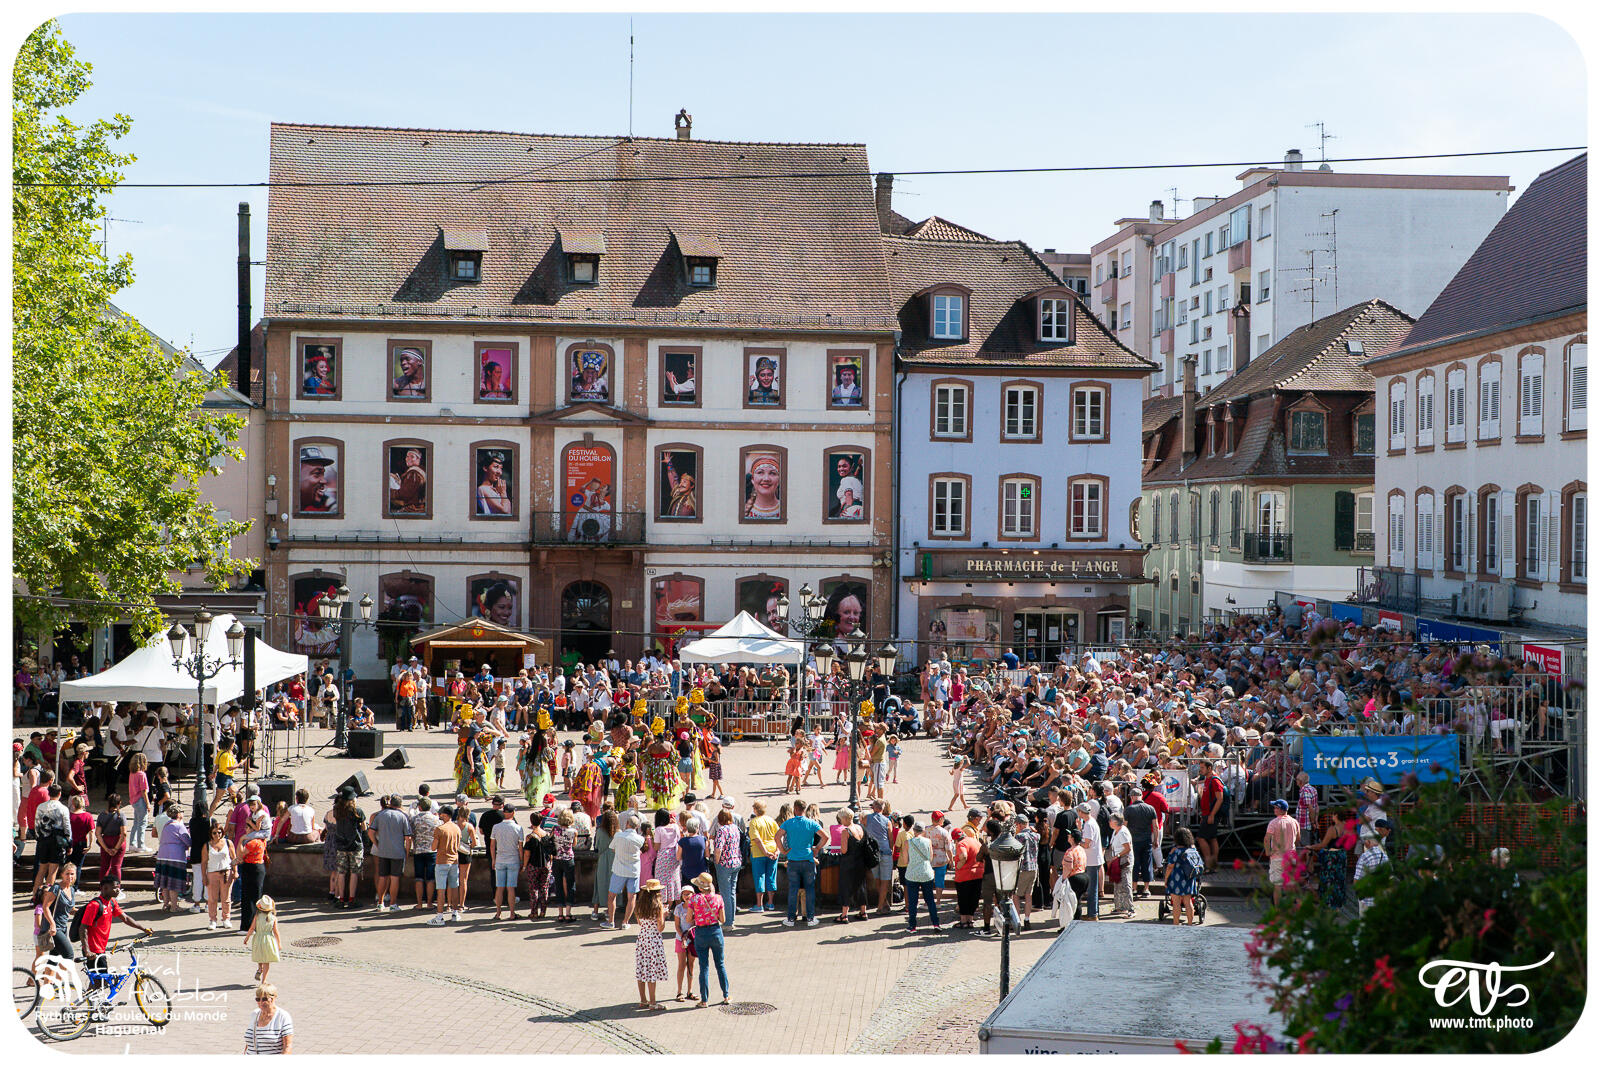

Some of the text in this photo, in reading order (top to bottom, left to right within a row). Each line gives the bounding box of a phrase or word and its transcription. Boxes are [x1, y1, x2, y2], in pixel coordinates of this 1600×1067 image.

[967, 560, 1044, 572] PHARMACIE
[1051, 560, 1064, 572] de
[1085, 560, 1119, 572] ANGE
